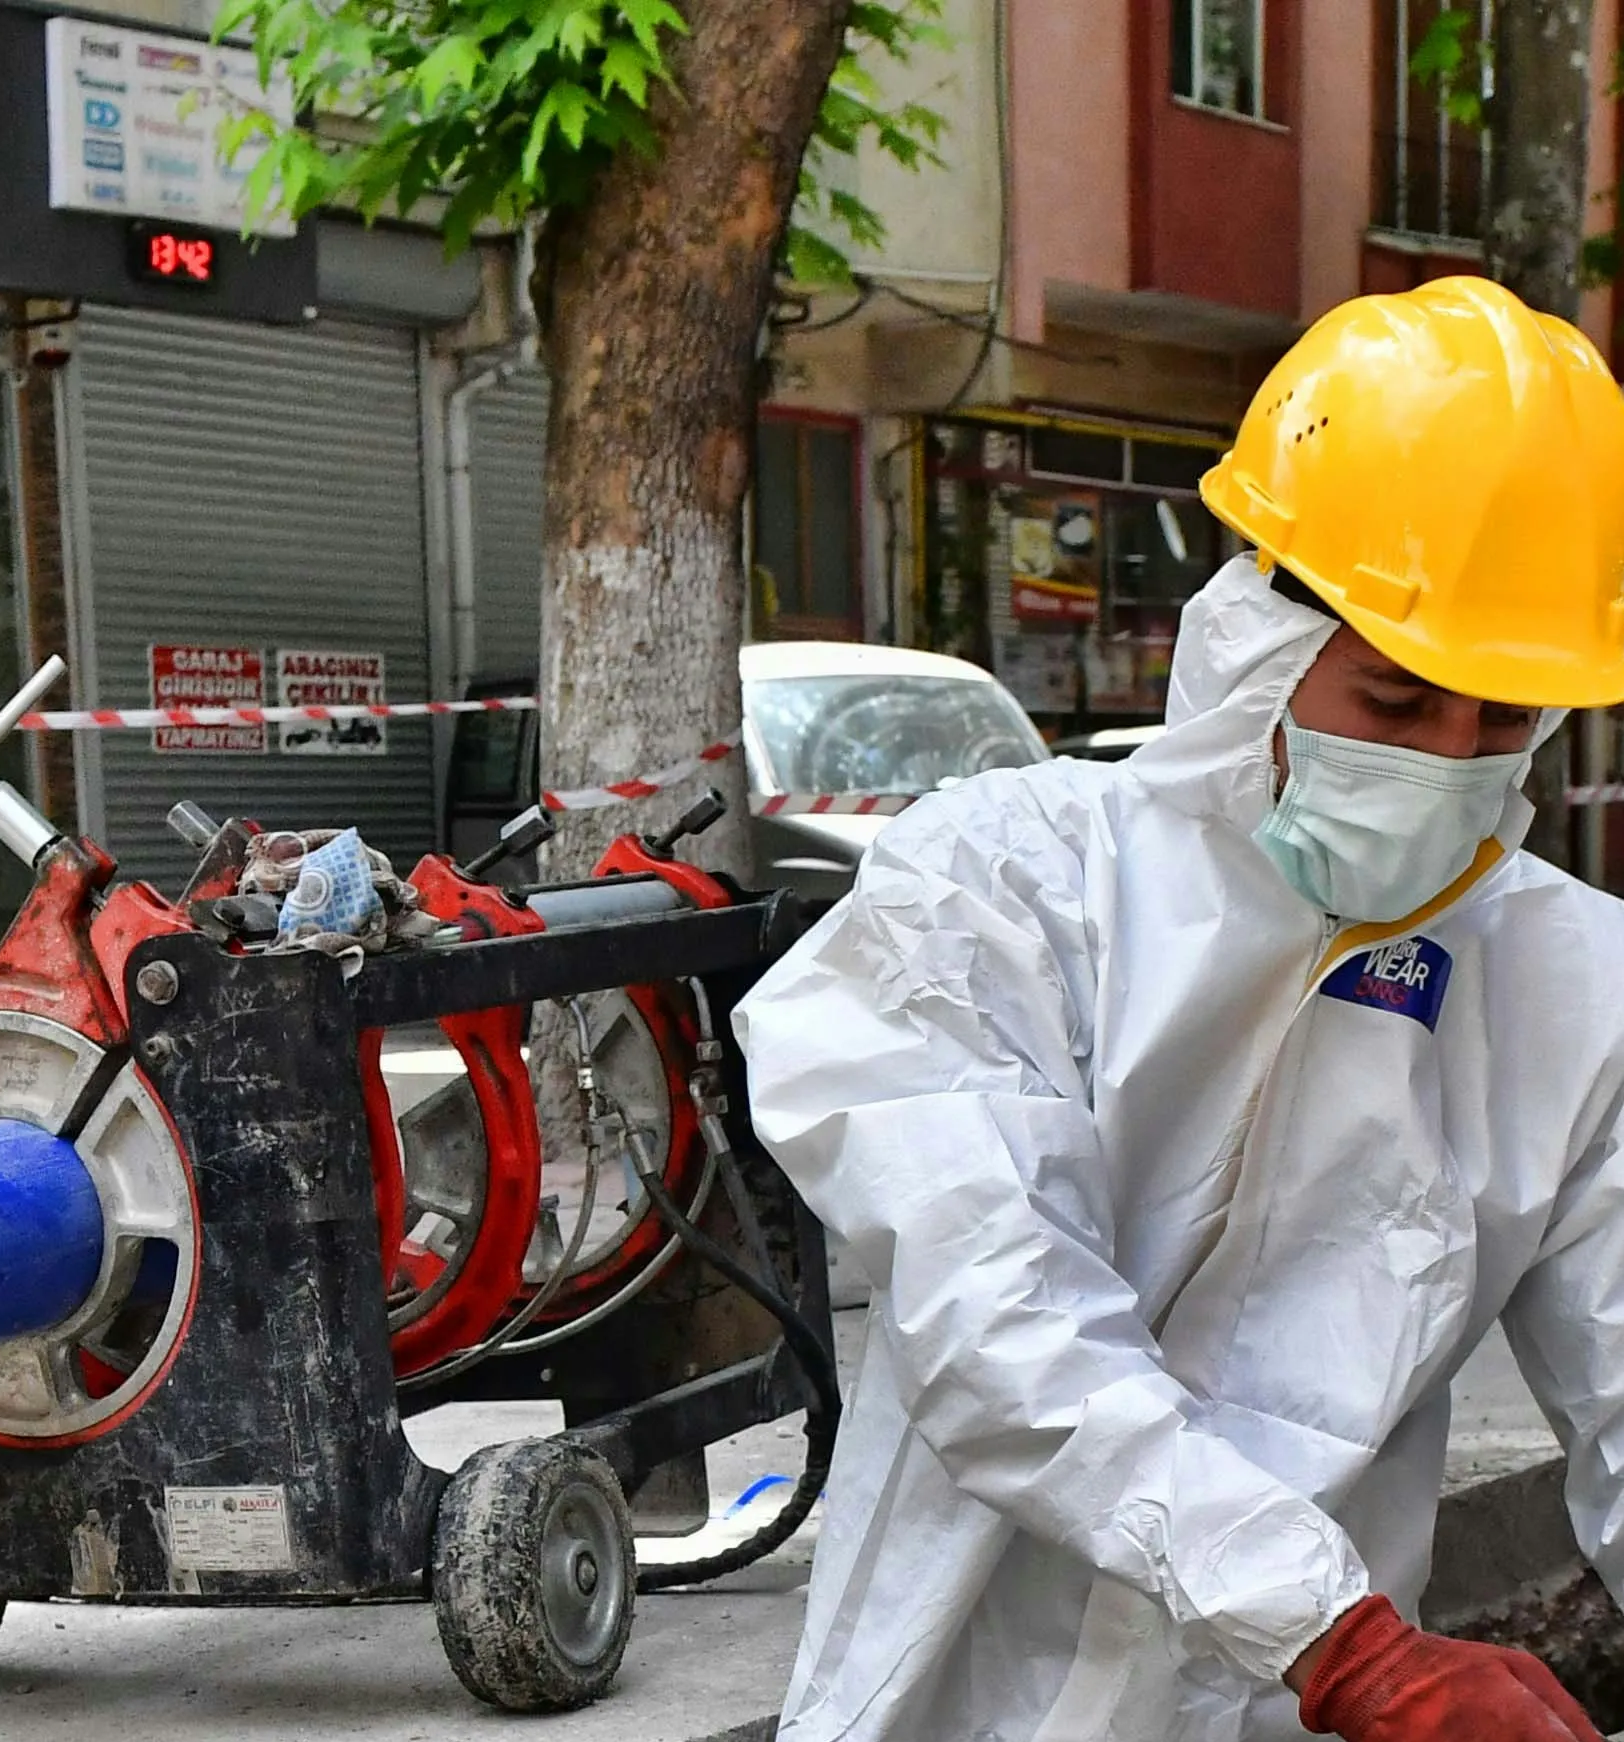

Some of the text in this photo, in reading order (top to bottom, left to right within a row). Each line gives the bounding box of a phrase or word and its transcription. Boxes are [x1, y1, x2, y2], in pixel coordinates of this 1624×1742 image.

[172, 649, 244, 673] GARAJ
[283, 655, 380, 678] ARACINIZ
[1362, 945, 1430, 991] WEAR
